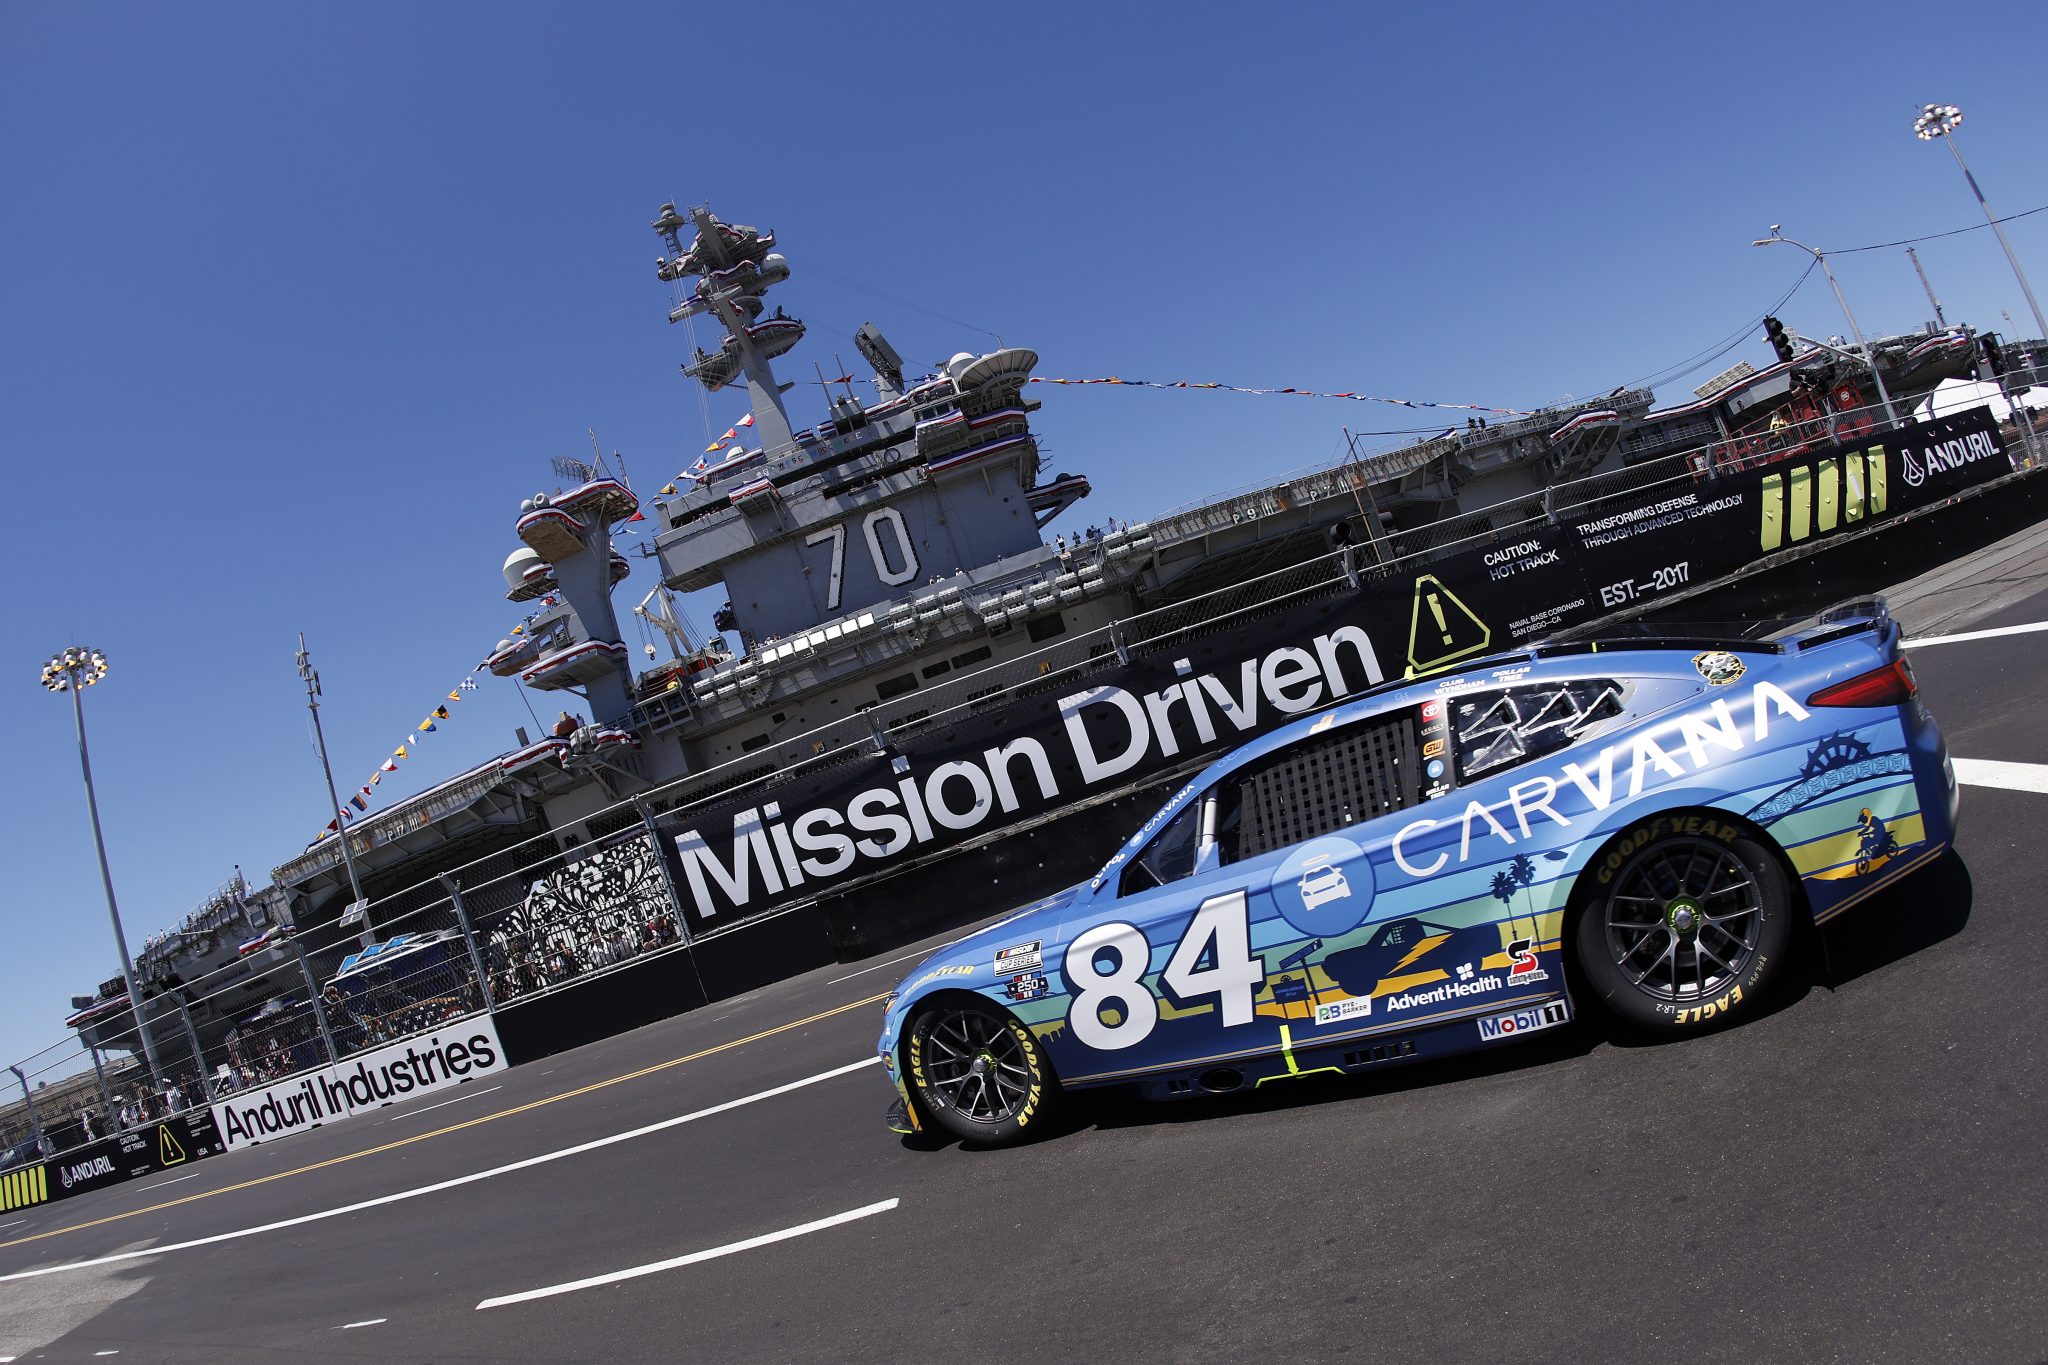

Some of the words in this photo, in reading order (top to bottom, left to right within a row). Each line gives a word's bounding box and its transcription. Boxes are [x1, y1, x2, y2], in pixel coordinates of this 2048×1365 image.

[1924, 430, 2000, 476] ANDURIL
[1247, 508, 1256, 519] 9
[1576, 505, 1656, 536] TRANSFORMING
[1656, 494, 1698, 514] DEFENSE
[1582, 527, 1633, 549] THROUGH
[1633, 512, 1684, 535] ADVANCED
[1683, 494, 1743, 519] TECHNOLOGY
[805, 506, 921, 611] 70
[1484, 540, 1542, 565] CAUTION:
[1489, 563, 1515, 581] HOT
[1516, 549, 1560, 571] TRACK
[1509, 618, 1531, 630] NAVAL
[1530, 611, 1548, 623] BASE
[1547, 598, 1585, 616] CORONADO
[1511, 627, 1527, 638] SAN
[1434, 680, 1486, 695] WYNDHAM
[1440, 679, 1465, 688] CLUB
[1491, 667, 1531, 678] DOLLAR
[1498, 674, 1523, 682] TREE
[1421, 723, 1445, 735] LEGACY
[674, 737, 1059, 918] Mission
[1057, 626, 1384, 784] Driven
[1392, 681, 1811, 877] CARVANA
[1426, 784, 1449, 796] DOLLAR
[1430, 791, 1445, 800] TREE
[1144, 784, 1195, 831] CARVANA
[1597, 816, 1742, 885] GOODYEAR
[1091, 853, 1126, 888] OLIPOP
[1001, 959, 1013, 969] CUP
[1013, 954, 1034, 967] SERIES
[1008, 943, 1036, 957] NASCAR
[904, 964, 975, 996] GOODYEAR
[1064, 889, 1263, 1051] 84
[1017, 979, 1039, 993] 250
[1342, 1004, 1368, 1015] BARKER
[1674, 984, 1744, 1024] EAGLE
[1481, 1008, 1542, 1037] Mobil
[1546, 1005, 1560, 1022] 1
[911, 1034, 928, 1088] EAGLE
[1008, 1018, 1041, 1127] GOODYEAR
[225, 1077, 323, 1145] Anduril
[323, 1033, 497, 1112] Industries
[120, 1133, 141, 1146] CAUTION:
[122, 1145, 133, 1154] HOT
[132, 1140, 147, 1151] TRACK
[197, 1147, 209, 1156] USA
[71, 1155, 116, 1183] ANDURIL
